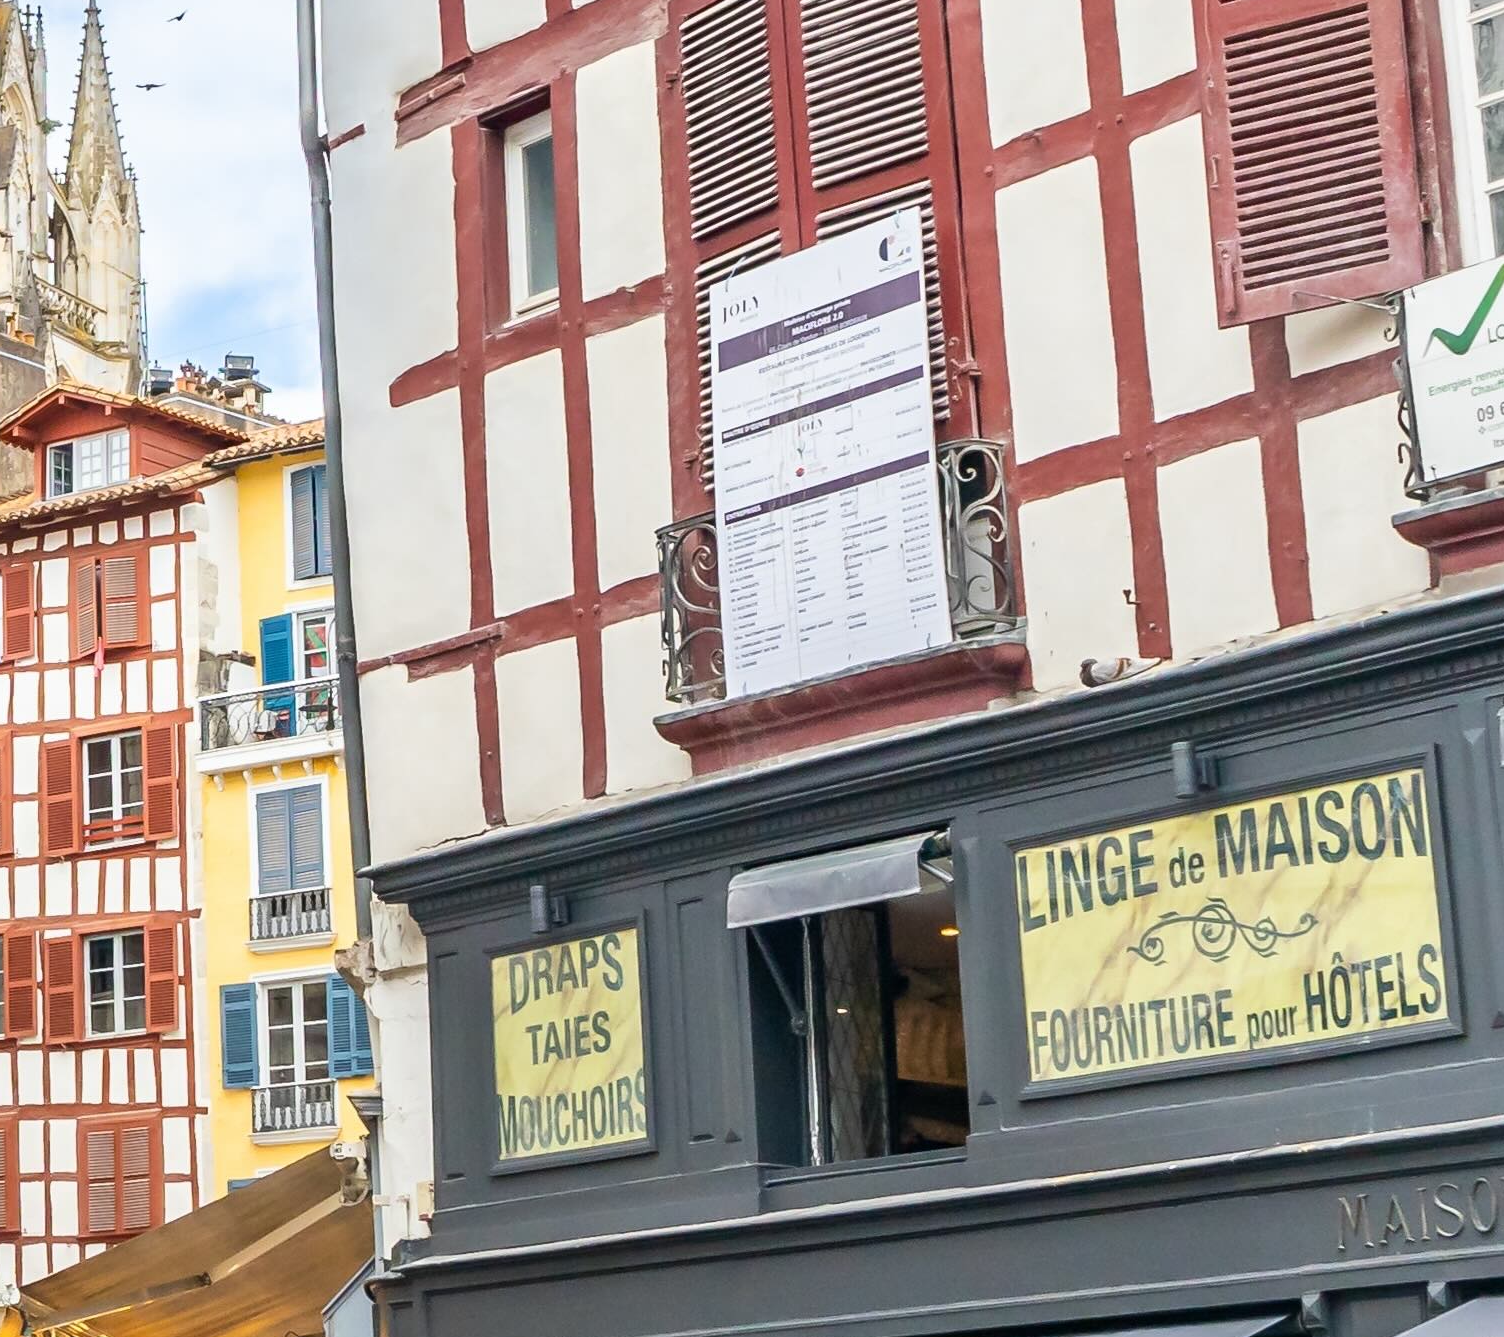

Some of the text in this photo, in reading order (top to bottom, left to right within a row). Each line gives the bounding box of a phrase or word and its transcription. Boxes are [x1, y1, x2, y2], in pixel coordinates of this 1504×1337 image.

[1428, 375, 1475, 397] Energies
[1476, 404, 1495, 423] 09
[1017, 774, 1429, 933] LINGE de MAISON
[507, 931, 624, 1015] DRAPS
[1030, 942, 1442, 1075] FOURNITURE pour HÔTELS
[525, 1010, 612, 1066] TAIES
[496, 1069, 648, 1156] MOUCHOIRS
